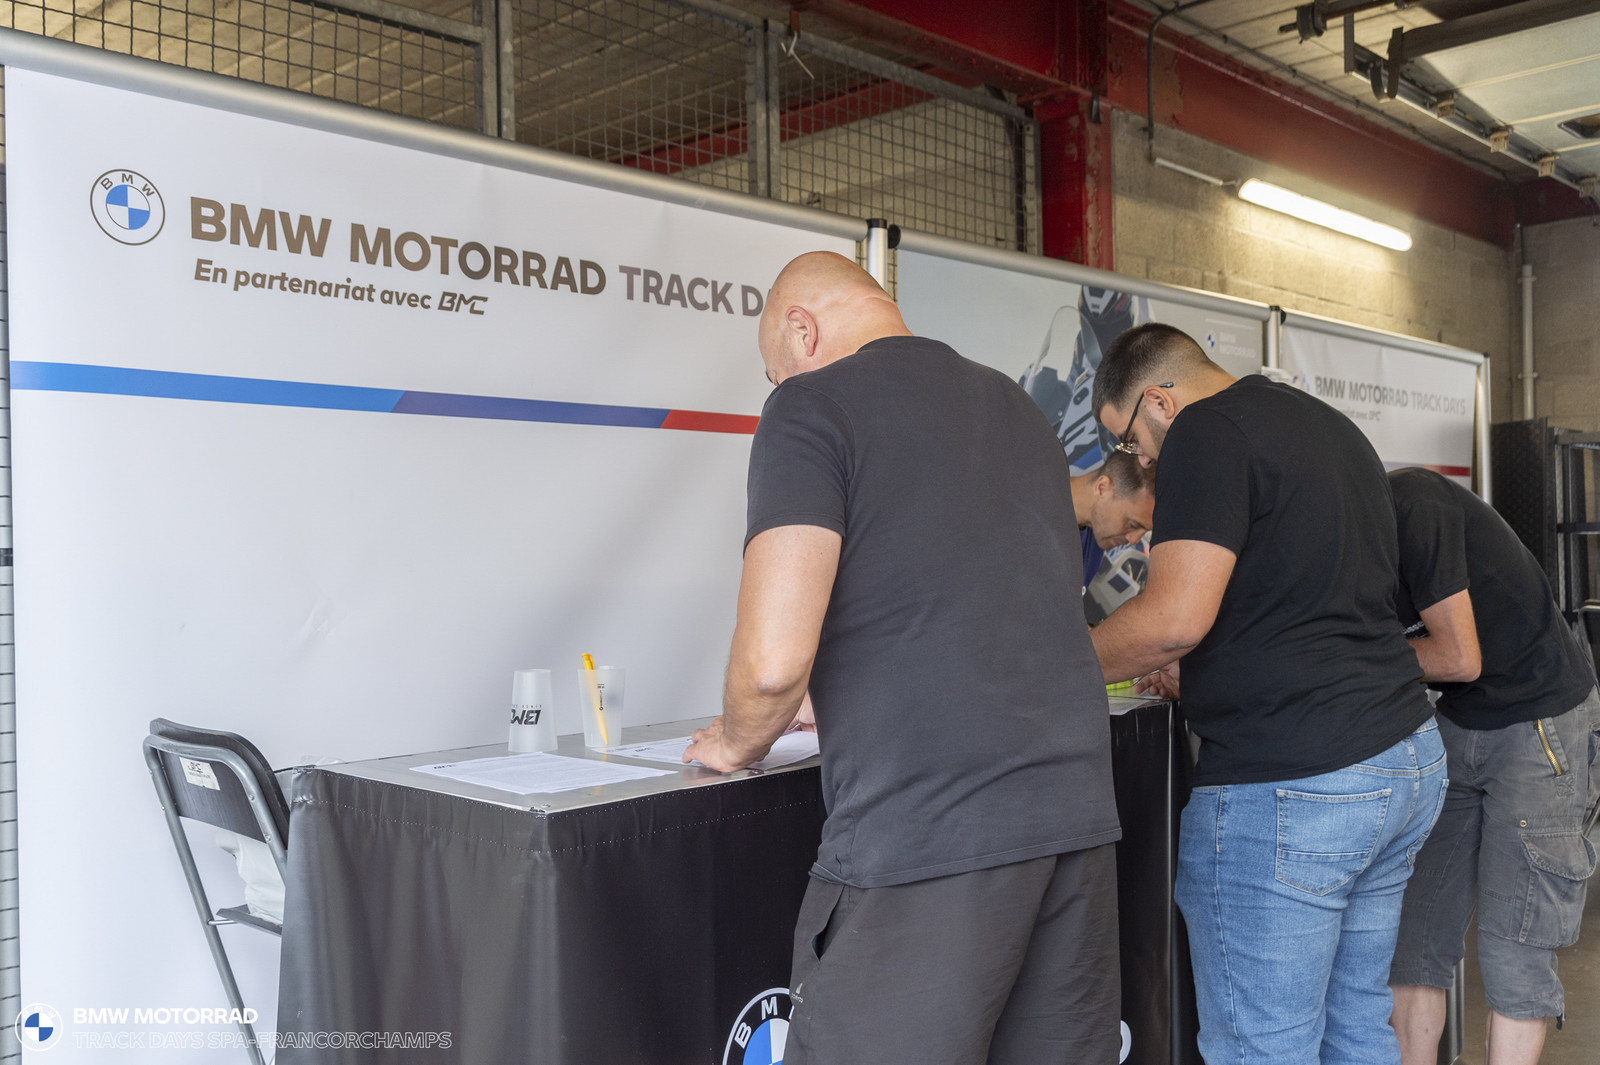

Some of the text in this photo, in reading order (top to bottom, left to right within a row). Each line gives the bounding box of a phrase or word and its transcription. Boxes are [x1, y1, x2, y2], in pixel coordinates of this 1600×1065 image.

[100, 173, 155, 197] BMW
[190, 196, 771, 317] BMW MOTORRAD TRACK D
[195, 258, 489, 315] En partenariat avec BMC
[1315, 375, 1466, 416] BMW MOTORRAD TRACK DAYS
[734, 996, 795, 1049] BM
